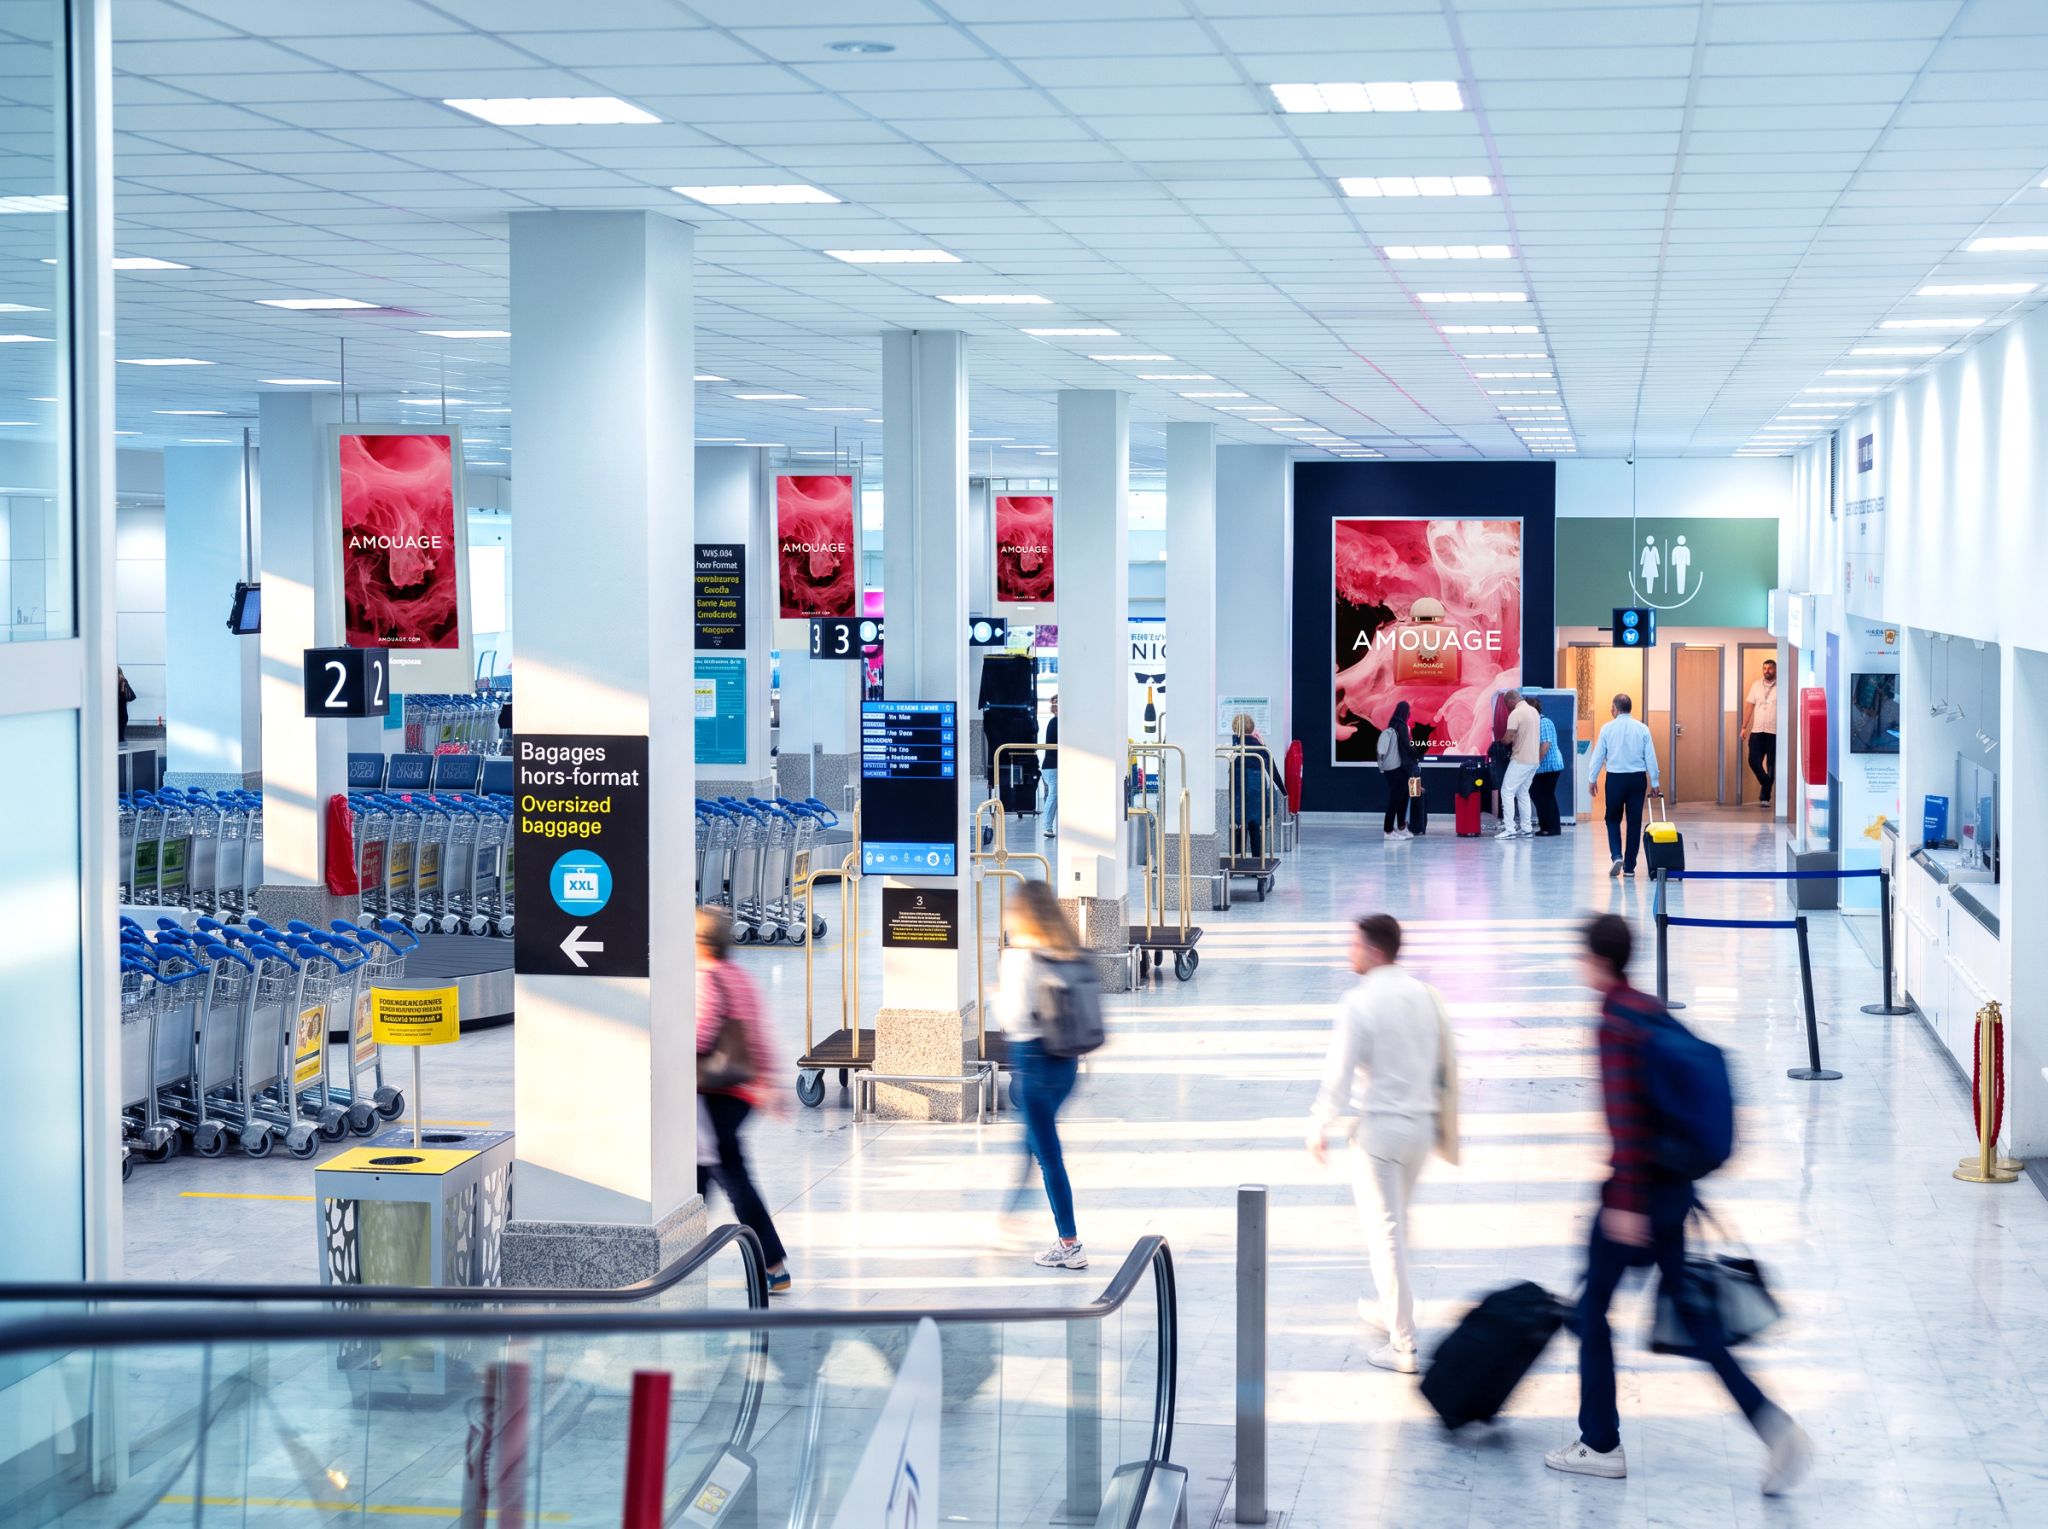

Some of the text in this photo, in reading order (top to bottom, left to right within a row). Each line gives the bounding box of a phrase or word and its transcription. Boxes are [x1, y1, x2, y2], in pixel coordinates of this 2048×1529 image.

[349, 535, 442, 549] AMOUAGE
[782, 543, 846, 553] AMOUAGE
[1001, 545, 1048, 554] AMOUAGE
[813, 623, 820, 654] 3
[835, 624, 850, 654] 3
[1352, 630, 1502, 651] AMOUAGE
[325, 660, 348, 708] 2
[373, 660, 384, 706] 2
[521, 741, 606, 765] Bagages
[521, 766, 640, 786] hors-format
[521, 795, 611, 813] Oversized
[522, 816, 602, 838] baggage
[569, 880, 595, 891] XXL
[916, 895, 924, 906] 3
